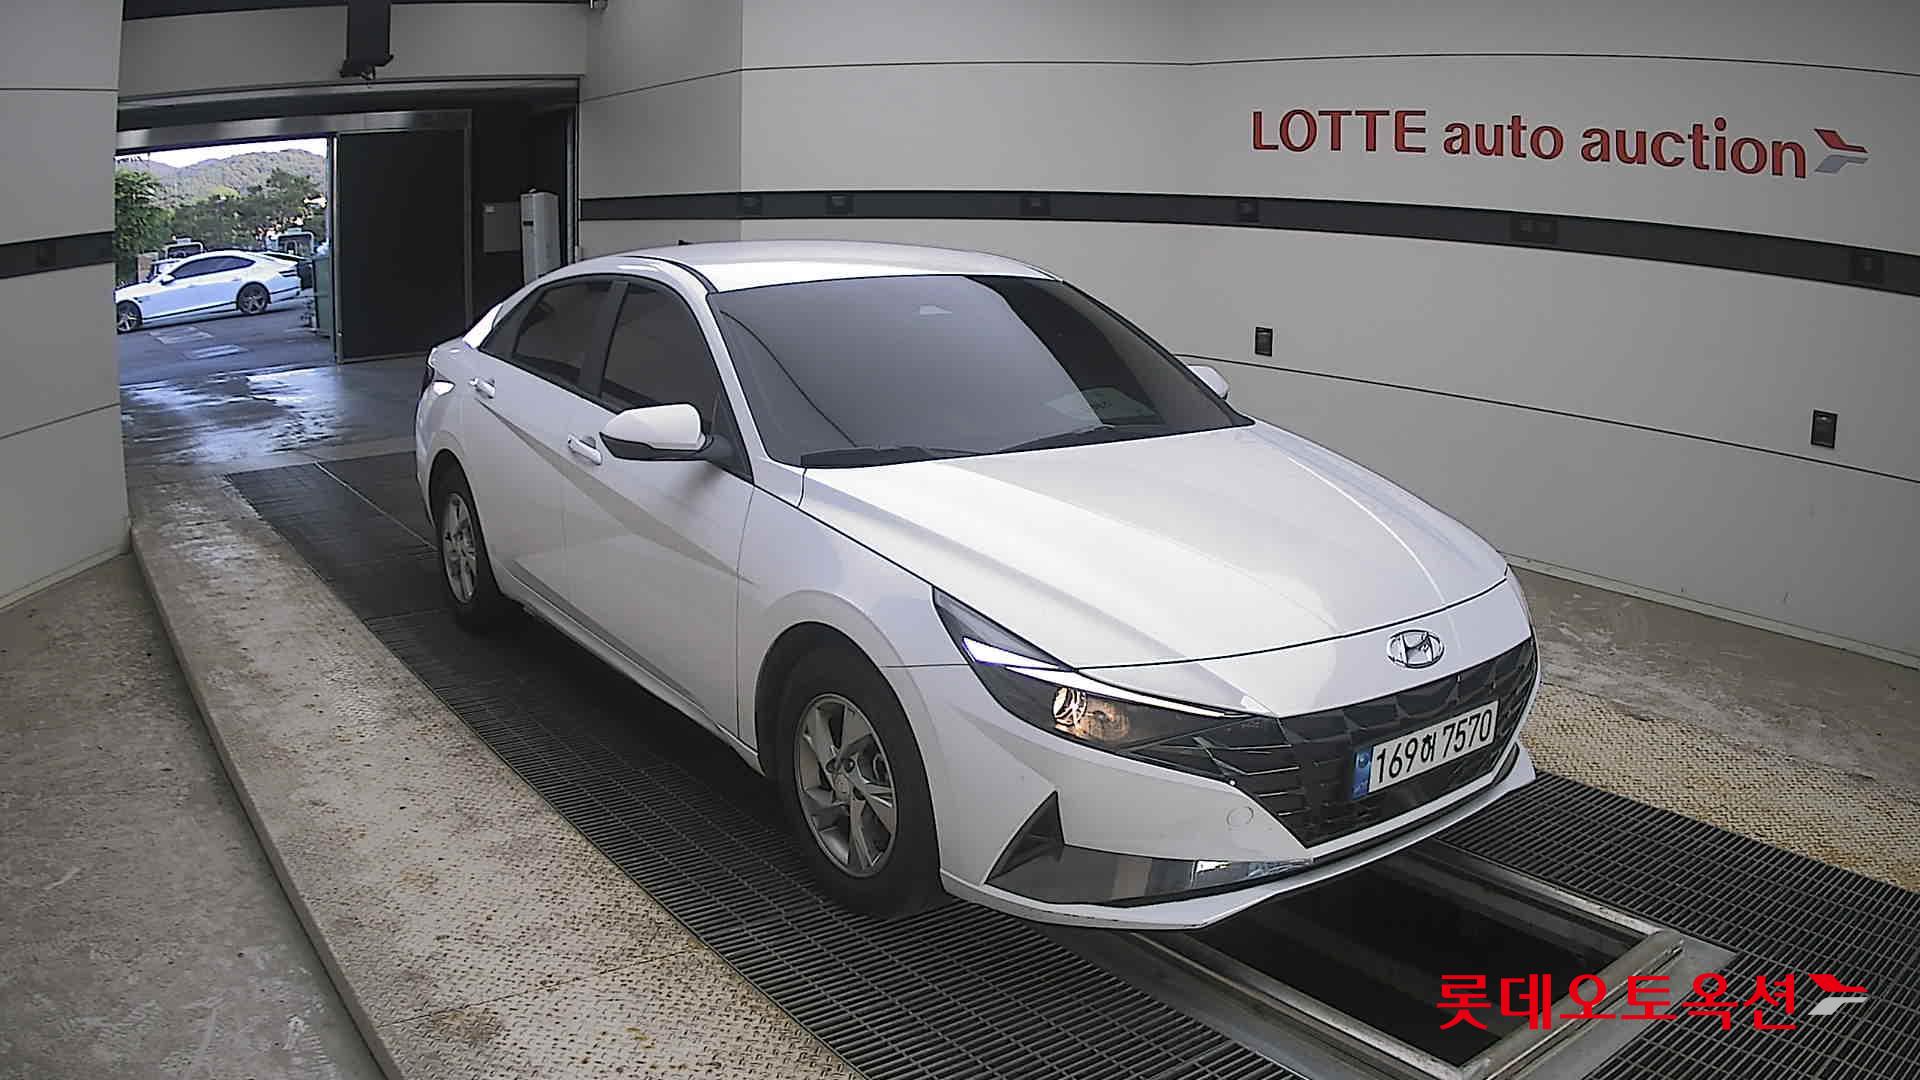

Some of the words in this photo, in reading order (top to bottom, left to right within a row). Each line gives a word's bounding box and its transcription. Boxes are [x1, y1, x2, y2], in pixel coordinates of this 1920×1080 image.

[1252, 110, 1427, 153] LOTTE
[1443, 115, 1565, 160] auto
[1580, 116, 1807, 179] auction
[1376, 731, 1437, 784] 169허
[1442, 708, 1493, 758] 7570
